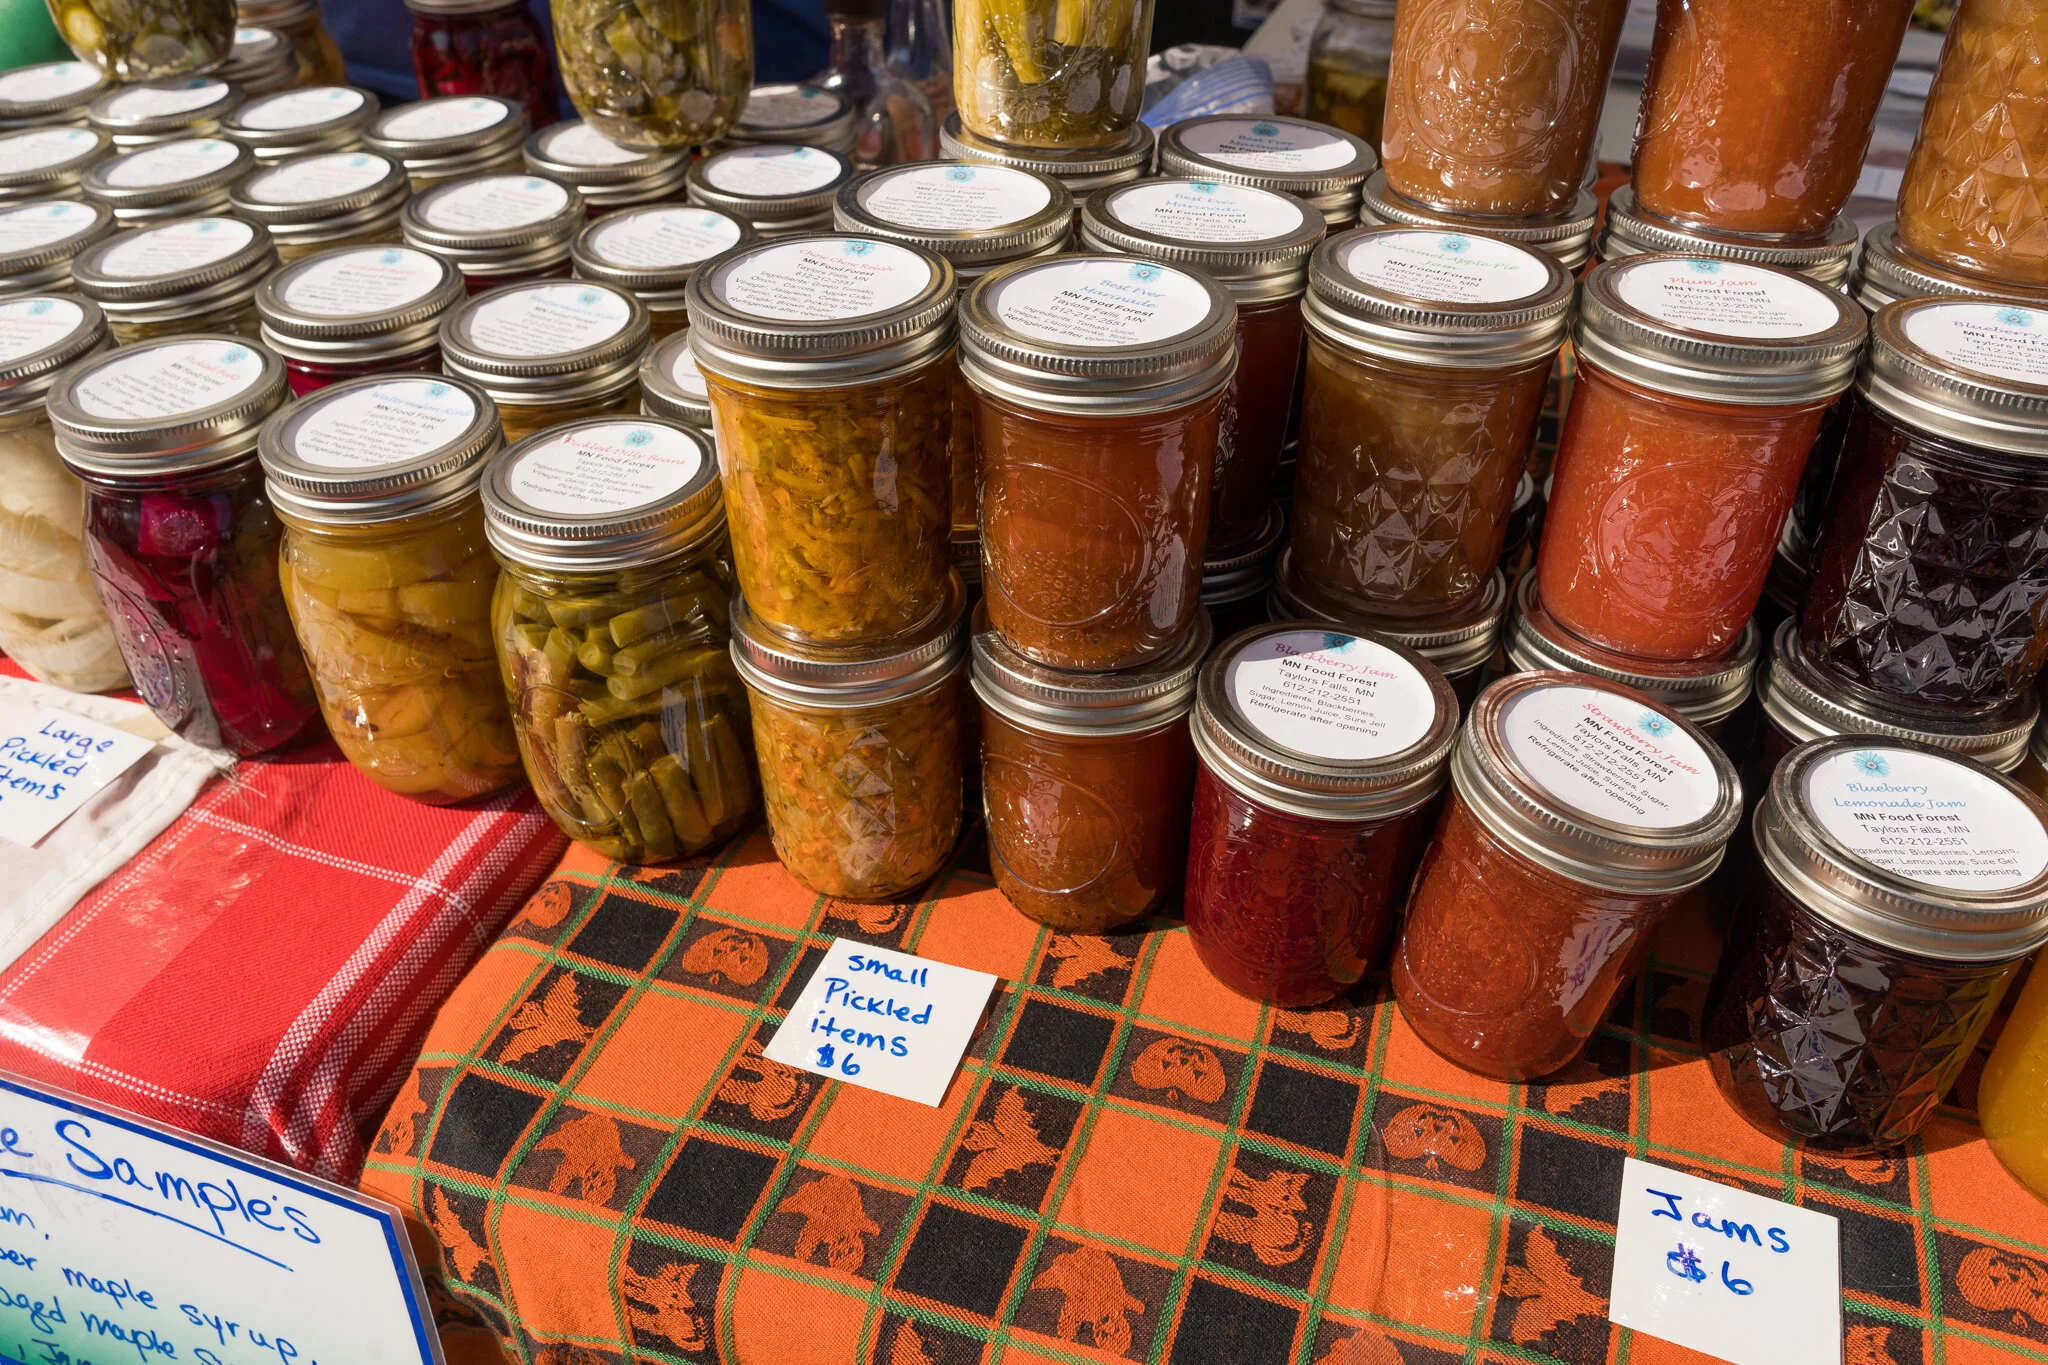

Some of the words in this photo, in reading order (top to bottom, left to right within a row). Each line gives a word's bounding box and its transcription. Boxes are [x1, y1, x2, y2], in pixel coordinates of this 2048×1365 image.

[796, 264, 828, 276] Taylors
[820, 262, 845, 272] Food
[846, 268, 874, 276] Forest
[1383, 265, 1422, 278] Taylors
[1426, 273, 1454, 283] Falls,
[1459, 280, 1479, 288] MN
[1387, 259, 1406, 267] MN
[1410, 264, 1441, 275] Food
[1443, 271, 1482, 282] Forest
[1100, 280, 1130, 292] Best
[1132, 287, 1167, 299] Ever
[1670, 277, 1717, 285] Plum
[1719, 279, 1757, 287] Jam
[1061, 290, 1081, 299] MN
[1083, 295, 1114, 308] Food
[1116, 305, 1153, 317] Forest
[1079, 285, 1158, 308] Marinade
[1667, 291, 1710, 300] Taylors
[1008, 307, 1042, 323] Vinegar,
[1044, 317, 1072, 331] Liquid
[1050, 304, 1126, 327] 612-212-2551
[1051, 296, 1090, 310] Taylors
[1093, 304, 1121, 319] Falls,
[1125, 315, 1146, 323] MN
[1663, 312, 1725, 323] Refrigerate
[1004, 313, 1057, 332] Refrigerate
[1060, 327, 1084, 339] after
[1085, 335, 1126, 344] opening
[1963, 330, 1985, 338] MN
[1990, 334, 2026, 344] Food
[1962, 336, 2012, 349] Taylors
[375, 403, 389, 411] MN
[560, 437, 613, 452] Pickled
[647, 454, 687, 465] Beans
[577, 450, 594, 458] MN
[595, 453, 622, 464] Food
[623, 458, 656, 469] Forest
[521, 480, 568, 497] Refrigerate
[570, 491, 589, 500] after
[1275, 643, 1358, 671] Blackberry
[1358, 666, 1399, 680] Jam
[1282, 659, 1301, 668] MN
[1305, 665, 1335, 678] Food
[1339, 672, 1378, 687] Forest
[1278, 668, 1318, 685] Taylors
[1321, 680, 1351, 693] Falls,
[1355, 688, 1375, 698] MN
[1283, 681, 1361, 705] 612-212-2551
[1249, 690, 1277, 702] Sugar,
[1281, 698, 1312, 711] Lemon
[1314, 705, 1340, 719] Juice,
[1345, 714, 1366, 724] Sure
[1369, 718, 1386, 728] Jell
[1250, 699, 1307, 719] Refrigerate
[1310, 715, 1333, 726] after
[1336, 721, 1378, 736] opening
[1318, 699, 1376, 718] Blackberries,
[40, 720, 114, 759] Large
[1583, 703, 1661, 754] Strawberry
[1659, 751, 1701, 775] Jam
[1583, 716, 1603, 731] MN
[1605, 730, 1635, 752] Food
[1635, 750, 1674, 776] Forest
[0, 737, 88, 777] Pickled
[1572, 734, 1646, 784] 612-212-2551
[1574, 723, 1612, 751] Taylors
[1613, 748, 1640, 770] Falls,
[1644, 769, 1666, 783] MN
[1528, 735, 1580, 772] Refrigerate
[1580, 771, 1603, 788] after
[1605, 787, 1646, 815] opening
[1547, 738, 1575, 759] Lemon
[1575, 759, 1600, 776] Juice,
[1603, 775, 1625, 791] Sure
[1626, 790, 1643, 802] Jell
[1582, 753, 1638, 791] Strawberries,
[1640, 789, 1670, 810] Sugar,
[1846, 783, 1928, 794] Blueberry
[1833, 797, 1924, 809] Lemonade
[1925, 800, 1966, 809] Jam
[1854, 813, 1876, 821] MN
[1918, 814, 1961, 822] Forest
[1860, 824, 1908, 834] Taylors
[1912, 826, 1946, 835] Falls,
[1880, 836, 1968, 845] 612-212-2551
[1866, 856, 1895, 865] Sugar,
[1939, 858, 1969, 866] Juice,
[1909, 849, 1969, 857] Blueberries,
[1888, 868, 1944, 877] efrigerate
[1945, 868, 1971, 876] after
[1974, 869, 2022, 877] opening
[825, 977, 933, 1025] Pickled
[811, 1010, 908, 1057] items
[1646, 1188, 1790, 1253] Jams
[62, 1267, 157, 1310] maple
